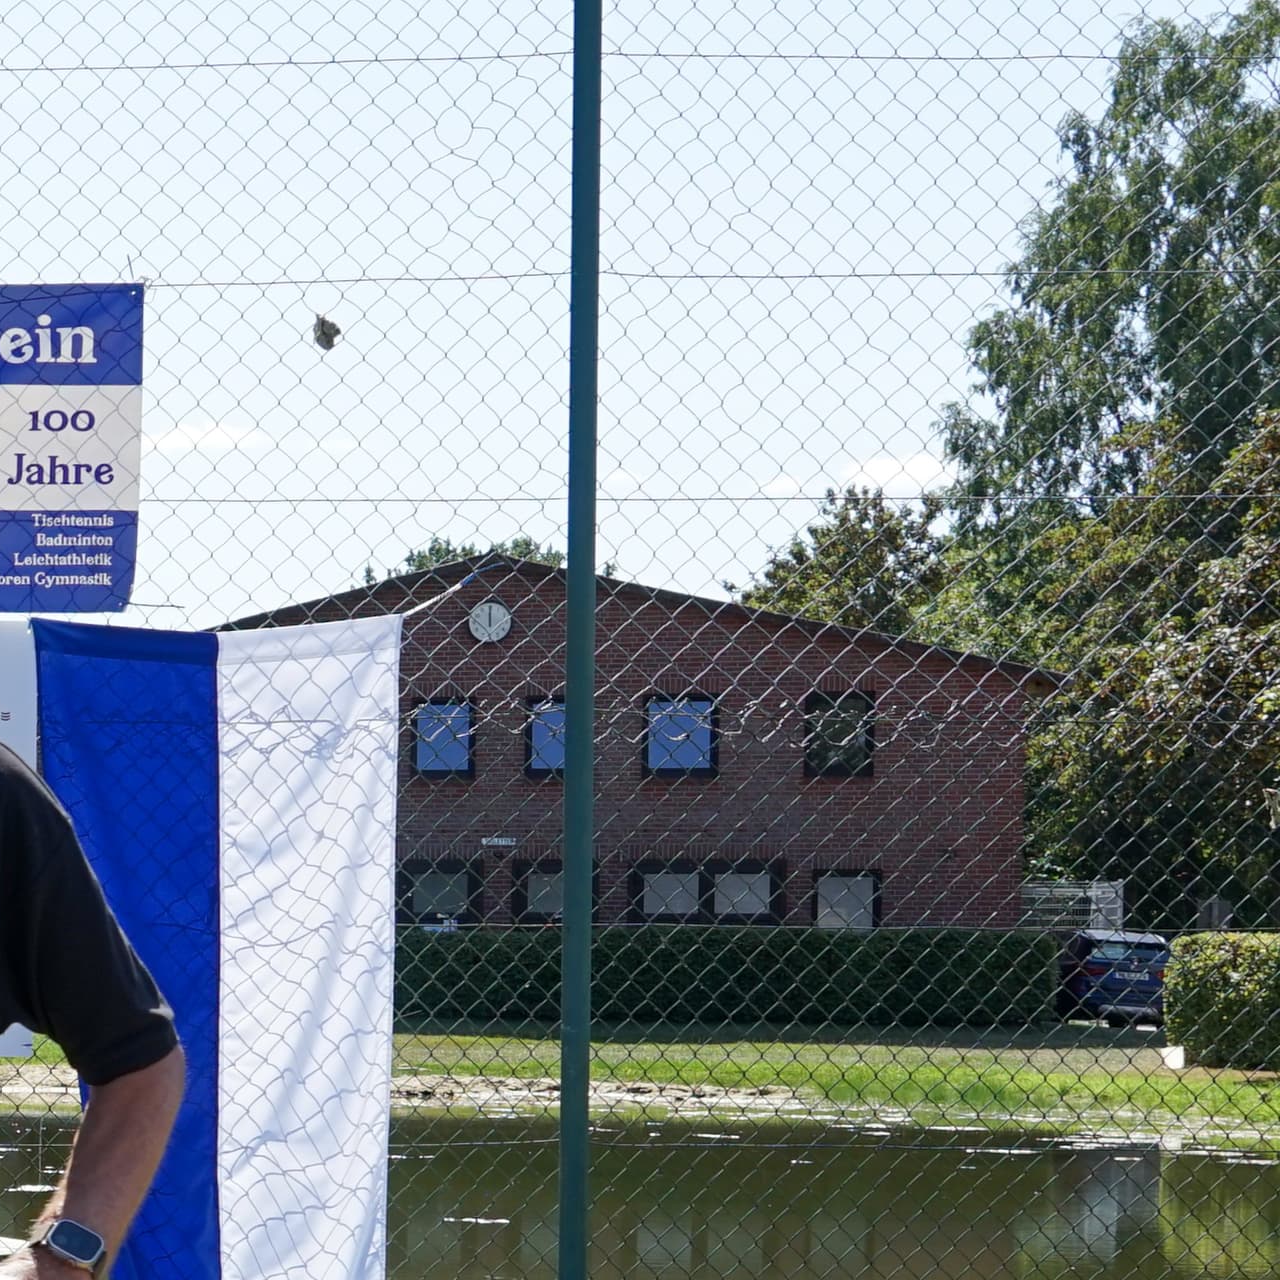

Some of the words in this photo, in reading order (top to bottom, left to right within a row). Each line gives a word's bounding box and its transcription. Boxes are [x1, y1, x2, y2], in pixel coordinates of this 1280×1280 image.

[28, 409, 96, 433] 100
[7, 453, 115, 485] Jahre
[31, 513, 114, 528] Tischtennis
[35, 533, 113, 547] Badminton
[13, 552, 113, 567] Leichtathletik
[33, 571, 113, 590] Gymnastik
